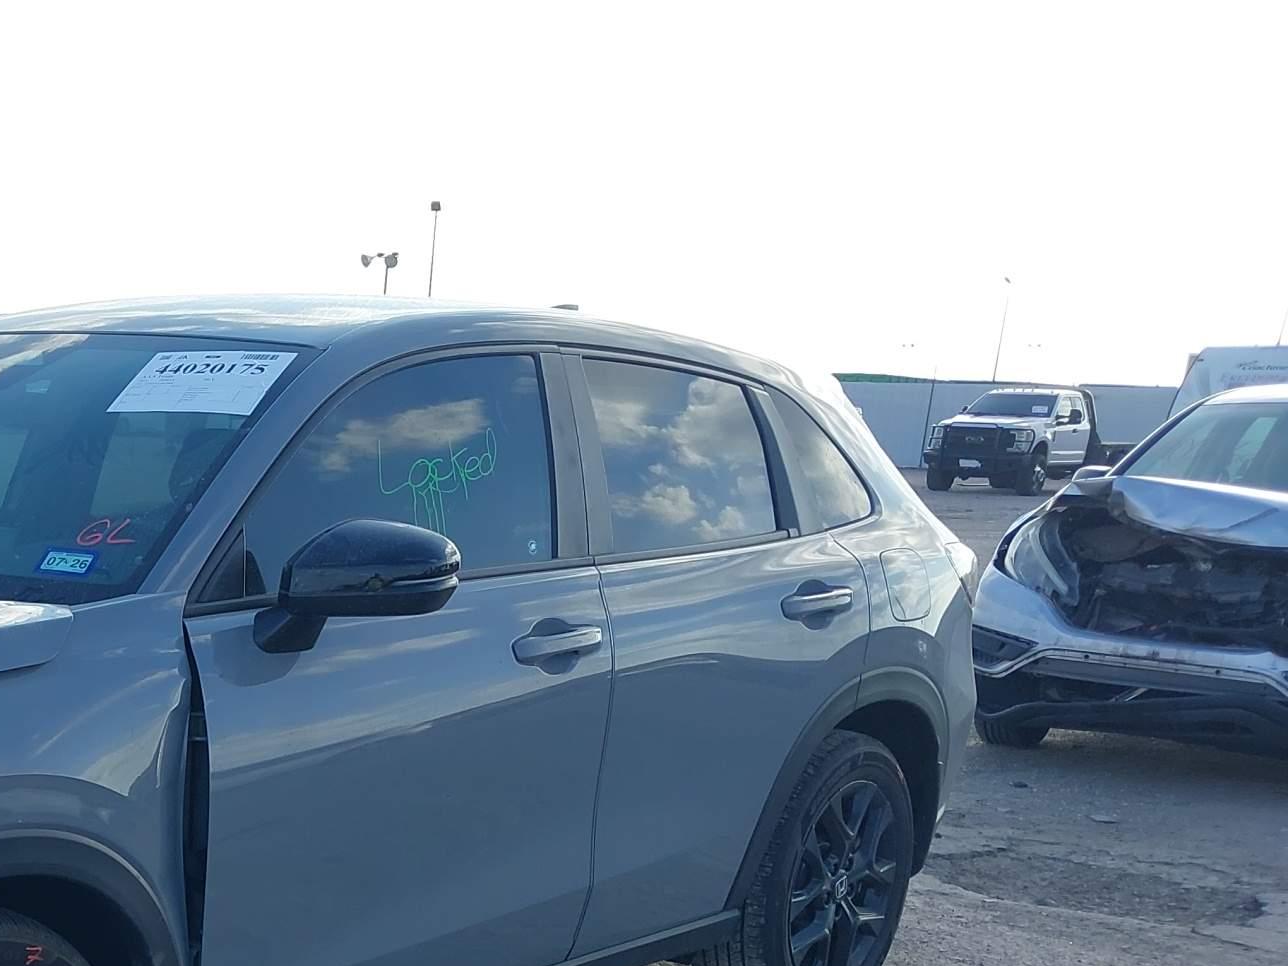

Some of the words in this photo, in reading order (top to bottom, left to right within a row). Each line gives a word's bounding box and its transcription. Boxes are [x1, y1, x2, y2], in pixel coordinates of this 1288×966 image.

[155, 363, 270, 376] 44020175
[377, 427, 497, 502] Locked
[76, 518, 136, 546] GL
[46, 556, 66, 567] 07
[70, 558, 89, 569] 26
